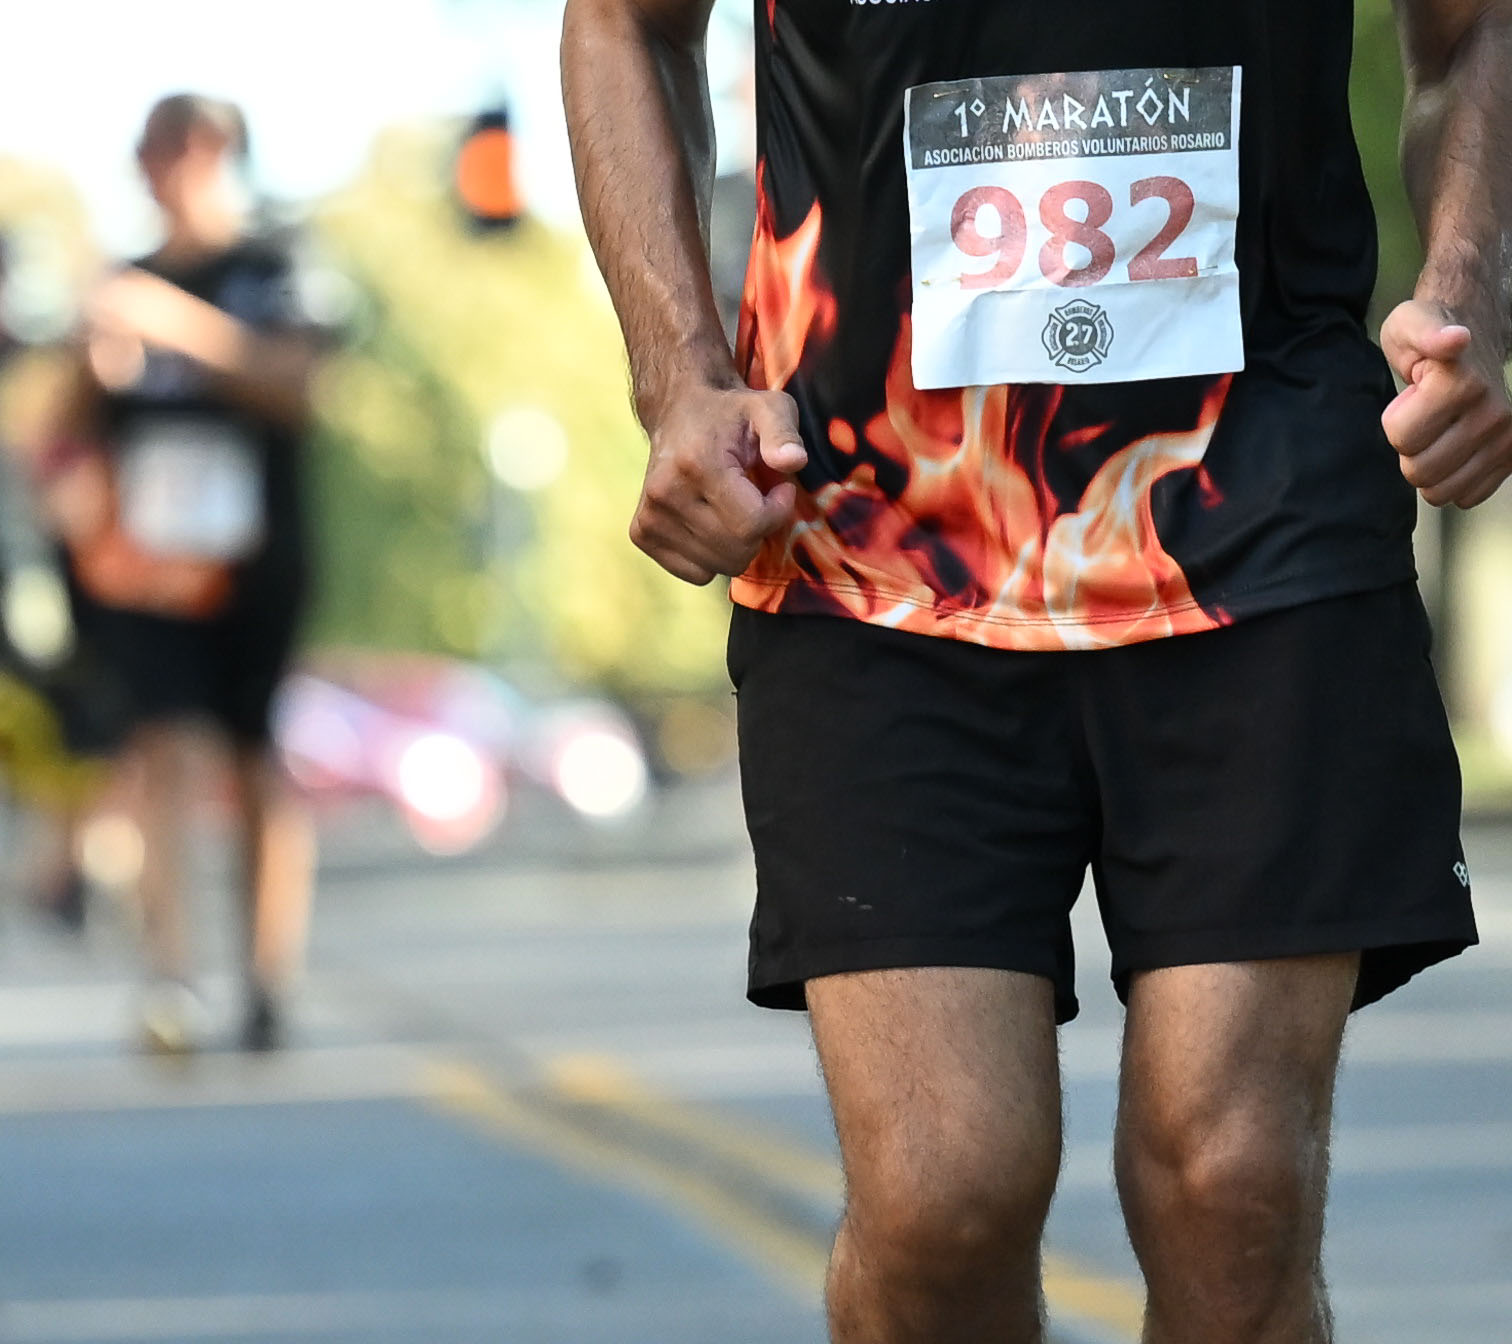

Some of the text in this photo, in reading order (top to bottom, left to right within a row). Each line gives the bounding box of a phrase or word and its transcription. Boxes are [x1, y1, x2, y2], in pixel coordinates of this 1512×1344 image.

[1001, 76, 1191, 134] MARATÓN
[924, 131, 1225, 166] ASOCIACIÓN BOMBEROS VOLUNTARIOS ROSARIO
[950, 175, 1199, 290] 982
[1065, 322, 1094, 347] 27
